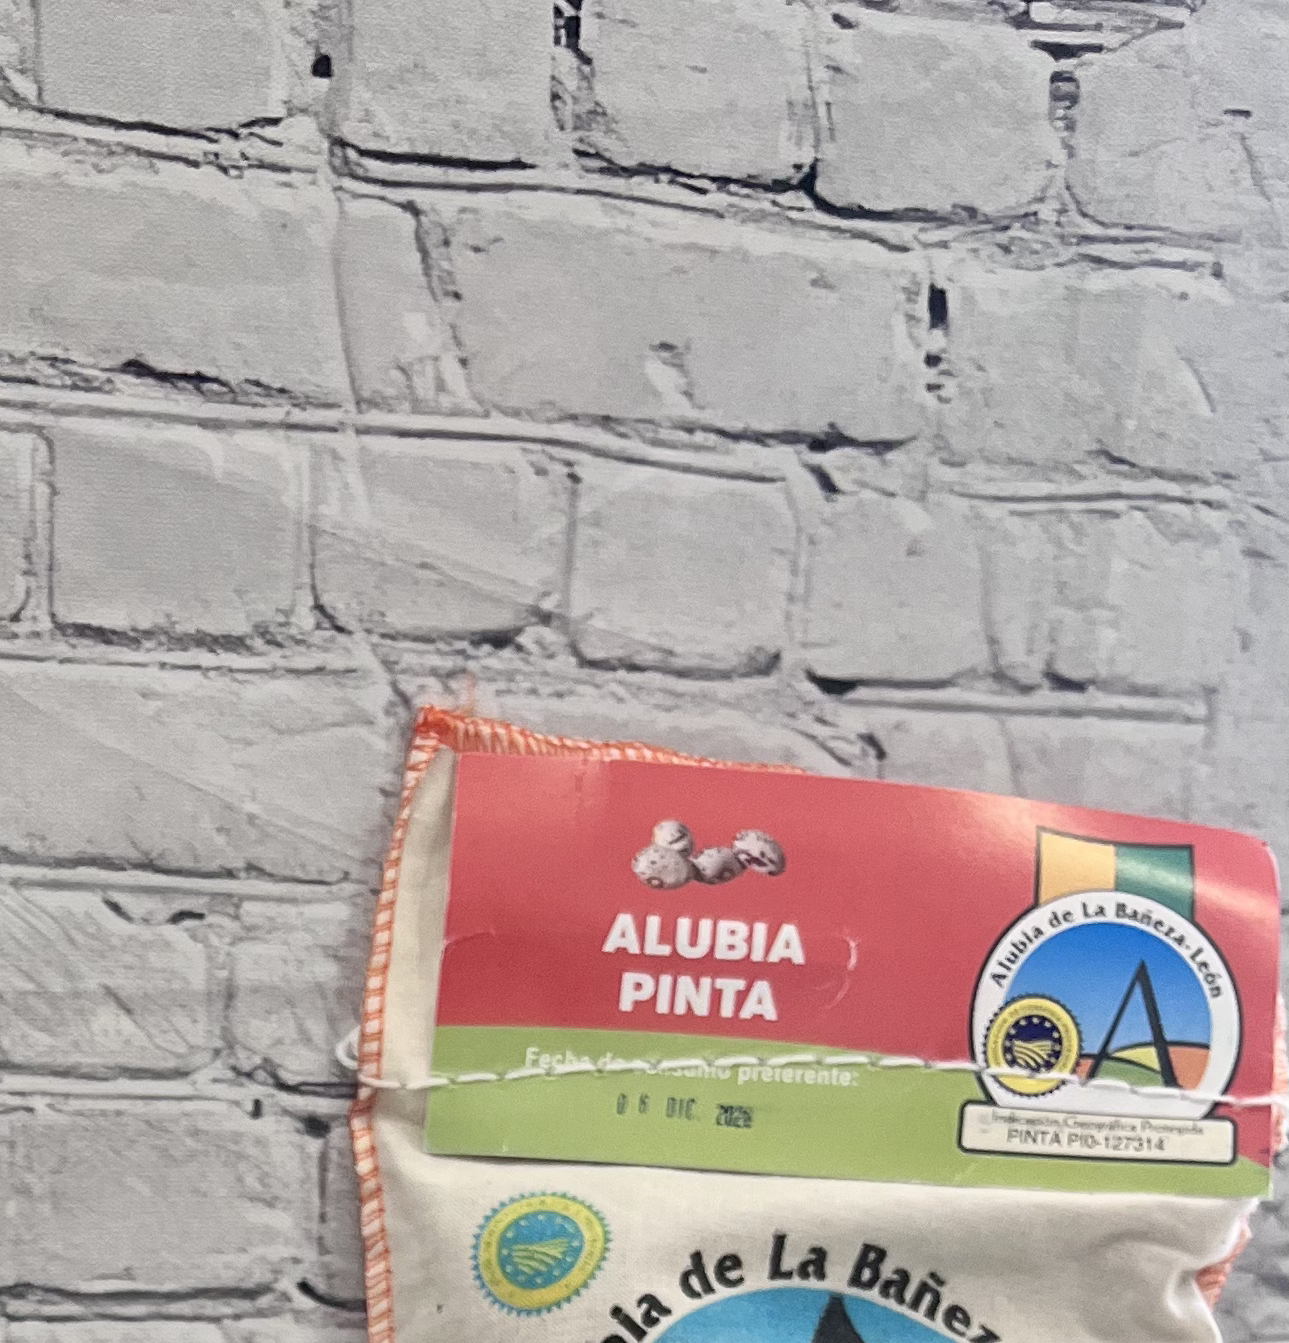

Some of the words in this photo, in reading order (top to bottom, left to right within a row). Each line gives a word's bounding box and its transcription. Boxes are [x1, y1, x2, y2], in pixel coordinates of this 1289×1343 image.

[602, 913, 806, 965] ALUBIA
[990, 924, 1044, 988] Alubia
[1048, 911, 1075, 930] de
[1082, 901, 1108, 918] La
[618, 971, 779, 1021] PINTA
[1007, 1129, 1062, 1147] PINTA
[679, 1251, 744, 1300] de
[767, 1233, 828, 1283] La
